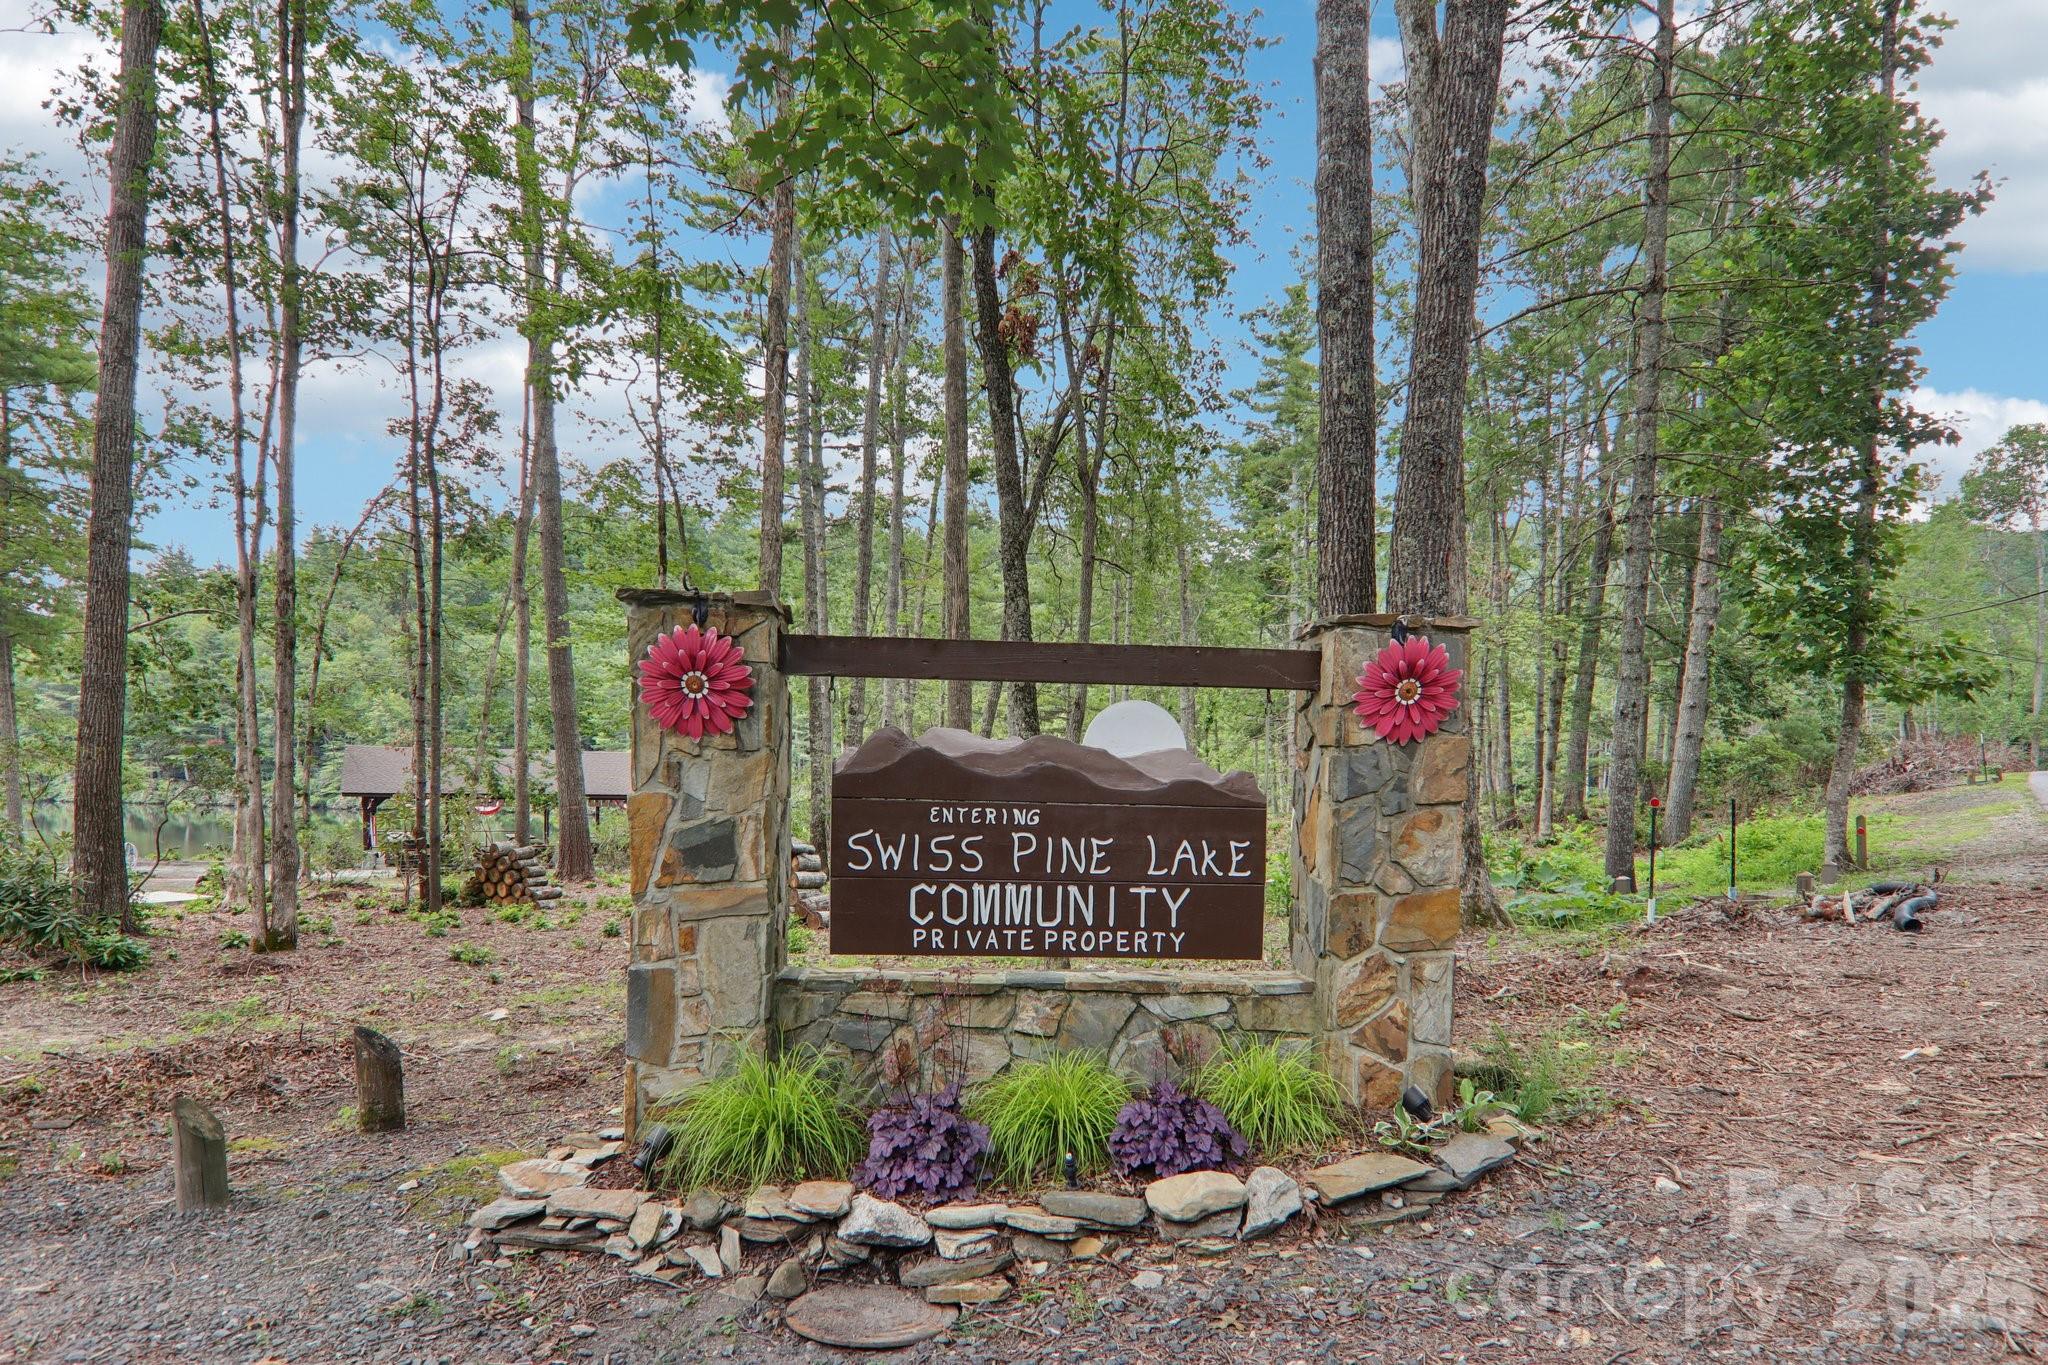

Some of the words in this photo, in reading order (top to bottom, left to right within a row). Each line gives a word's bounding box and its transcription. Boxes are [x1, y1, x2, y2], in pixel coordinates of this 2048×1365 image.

[930, 806, 1040, 826] ENTERING
[848, 829, 983, 872] SWISS
[1012, 832, 1115, 874] PINE
[909, 882, 1190, 928] COMMUNITY
[913, 929, 1034, 951] PRIVATE
[1045, 930, 1186, 953] PROPERTY
